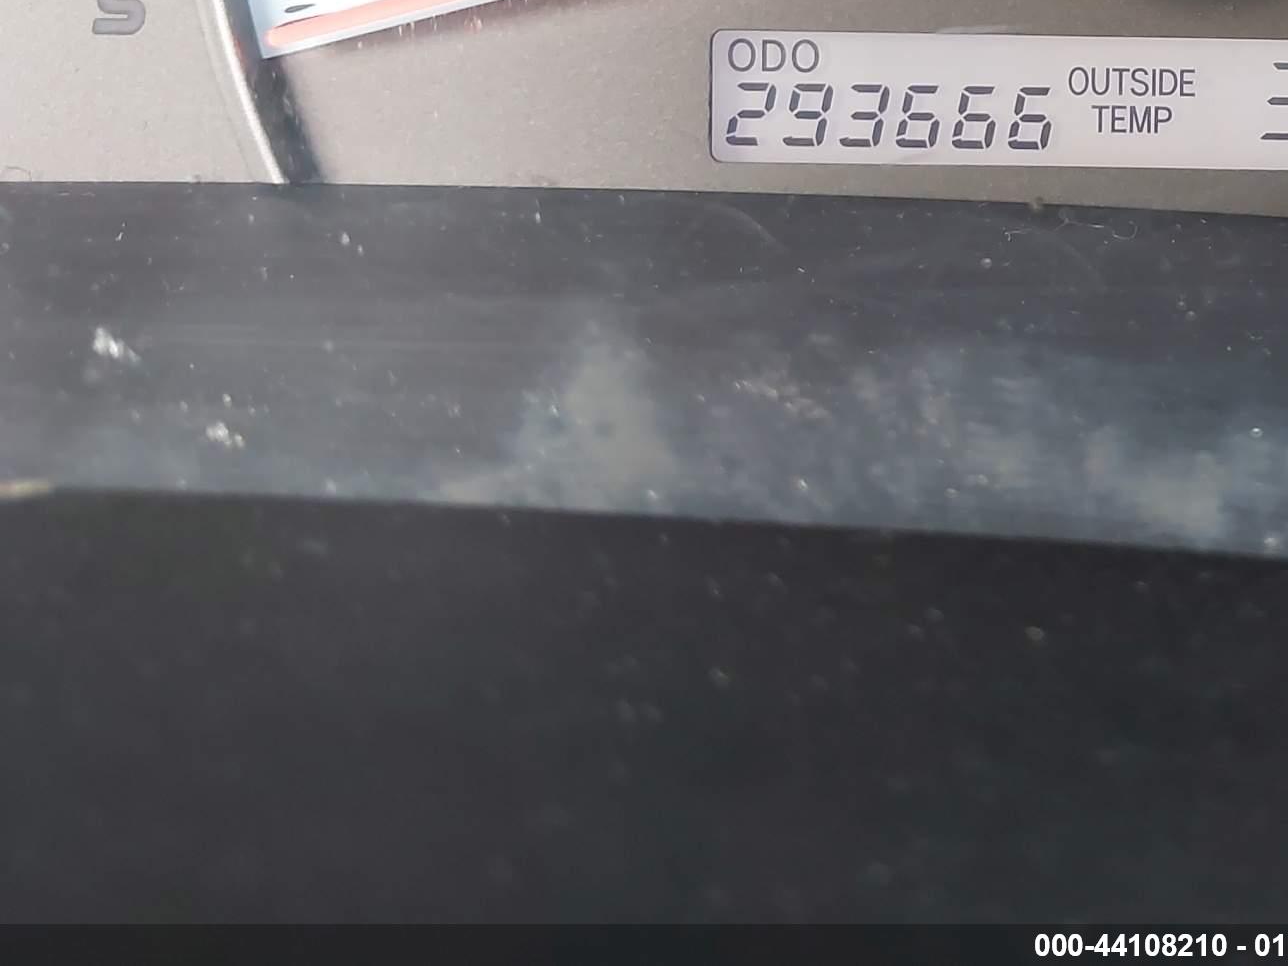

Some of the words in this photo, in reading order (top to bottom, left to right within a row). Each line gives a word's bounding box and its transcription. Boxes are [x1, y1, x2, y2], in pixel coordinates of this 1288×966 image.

[727, 37, 821, 73] ODO
[1067, 66, 1197, 98] OUTSIDE
[726, 81, 1053, 151] 293666
[1091, 104, 1174, 135] TEMP
